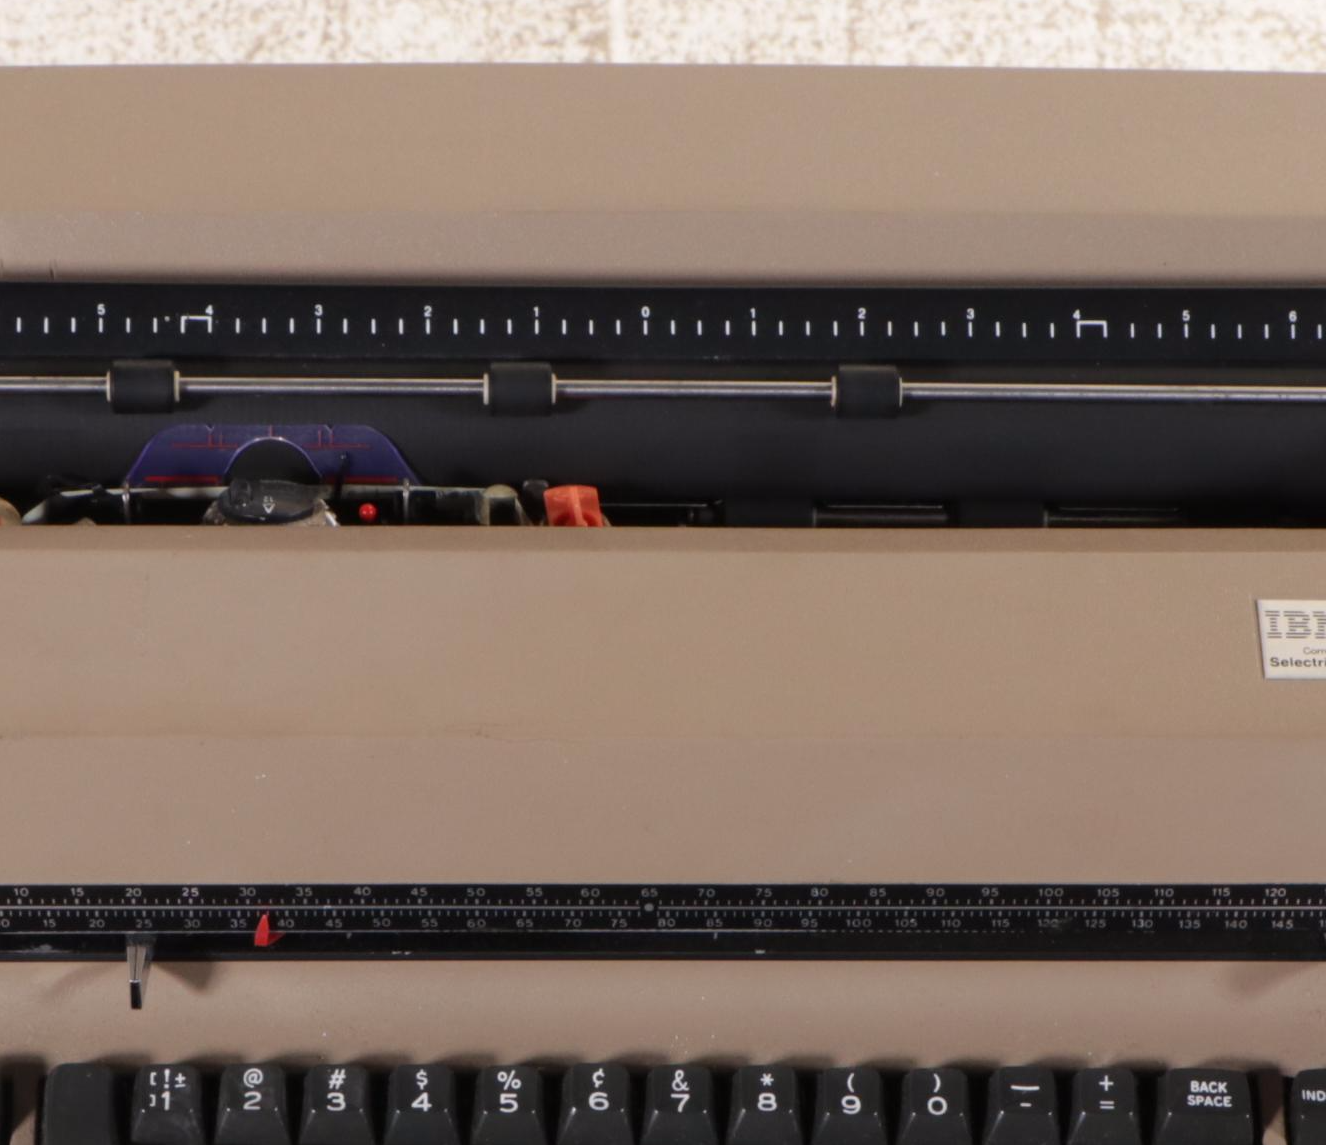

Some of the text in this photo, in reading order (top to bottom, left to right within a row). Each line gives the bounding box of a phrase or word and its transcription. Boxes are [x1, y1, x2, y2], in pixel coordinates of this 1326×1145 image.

[97, 303, 106, 315] 5
[205, 304, 214, 315] 4
[314, 304, 323, 316] 3
[423, 305, 433, 317] 2
[533, 306, 539, 318] 1
[641, 305, 650, 317] 0
[750, 307, 756, 318] 1
[857, 307, 867, 319] 2
[966, 307, 975, 319] 3
[1072, 309, 1082, 321] 4
[1182, 309, 1191, 321] 5
[1288, 310, 1298, 322] 6
[14, 888, 29, 896] 10
[71, 888, 84, 896] 15
[126, 888, 141, 896] 20
[183, 887, 198, 896] 25
[240, 887, 256, 896] 30
[297, 887, 312, 896] 35
[354, 887, 371, 895] 40
[411, 887, 427, 896] 45
[467, 888, 485, 896] 50
[526, 887, 542, 896] 55
[581, 888, 600, 897] 60
[641, 888, 657, 897] 65
[699, 888, 715, 897] 70
[757, 888, 772, 897] 75
[812, 888, 828, 896] 80
[870, 888, 886, 897] 85
[926, 888, 945, 897] 90
[982, 887, 998, 896] 95
[1039, 888, 1063, 896] 100
[1098, 888, 1119, 897] 105
[1155, 888, 1174, 897] 110
[1213, 888, 1230, 896] 115
[1266, 888, 1286, 897] 120
[43, 919, 56, 927] 15
[90, 919, 105, 928] 20
[136, 919, 152, 928] 25
[185, 919, 200, 928] 30
[231, 919, 246, 928] 35
[278, 919, 294, 928] 40
[326, 919, 342, 928] 45
[373, 918, 390, 927] 50
[422, 918, 438, 927] 55
[467, 919, 486, 929] 60
[516, 919, 533, 927] 65
[566, 919, 581, 927] 70
[612, 919, 627, 927] 75
[658, 919, 675, 927] 80
[706, 919, 722, 929] 85
[754, 919, 772, 927] 90
[801, 918, 817, 927] 95
[847, 919, 871, 927] 100
[942, 919, 961, 927] 110
[992, 919, 1009, 927] 115
[1086, 919, 1106, 928] 125
[1133, 919, 1152, 927] 130
[1180, 920, 1200, 928] 135
[1225, 920, 1247, 929] 140
[1272, 920, 1293, 929] 145
[244, 1068, 263, 1088] @
[329, 1069, 345, 1089] #
[416, 1070, 428, 1089] $
[498, 1070, 521, 1090] %
[672, 1070, 689, 1091] &
[846, 1073, 855, 1092] (
[933, 1074, 941, 1092] )
[1099, 1075, 1113, 1091] +
[1191, 1081, 1227, 1093] BACK
[244, 1091, 261, 1109] 2
[327, 1092, 345, 1111] 3
[412, 1093, 431, 1111] 4
[500, 1094, 518, 1112] 5
[589, 1092, 609, 1110] 6
[671, 1094, 689, 1112] 7
[758, 1093, 777, 1111] 8
[842, 1096, 861, 1114] 9
[1188, 1095, 1232, 1107] SPACE
